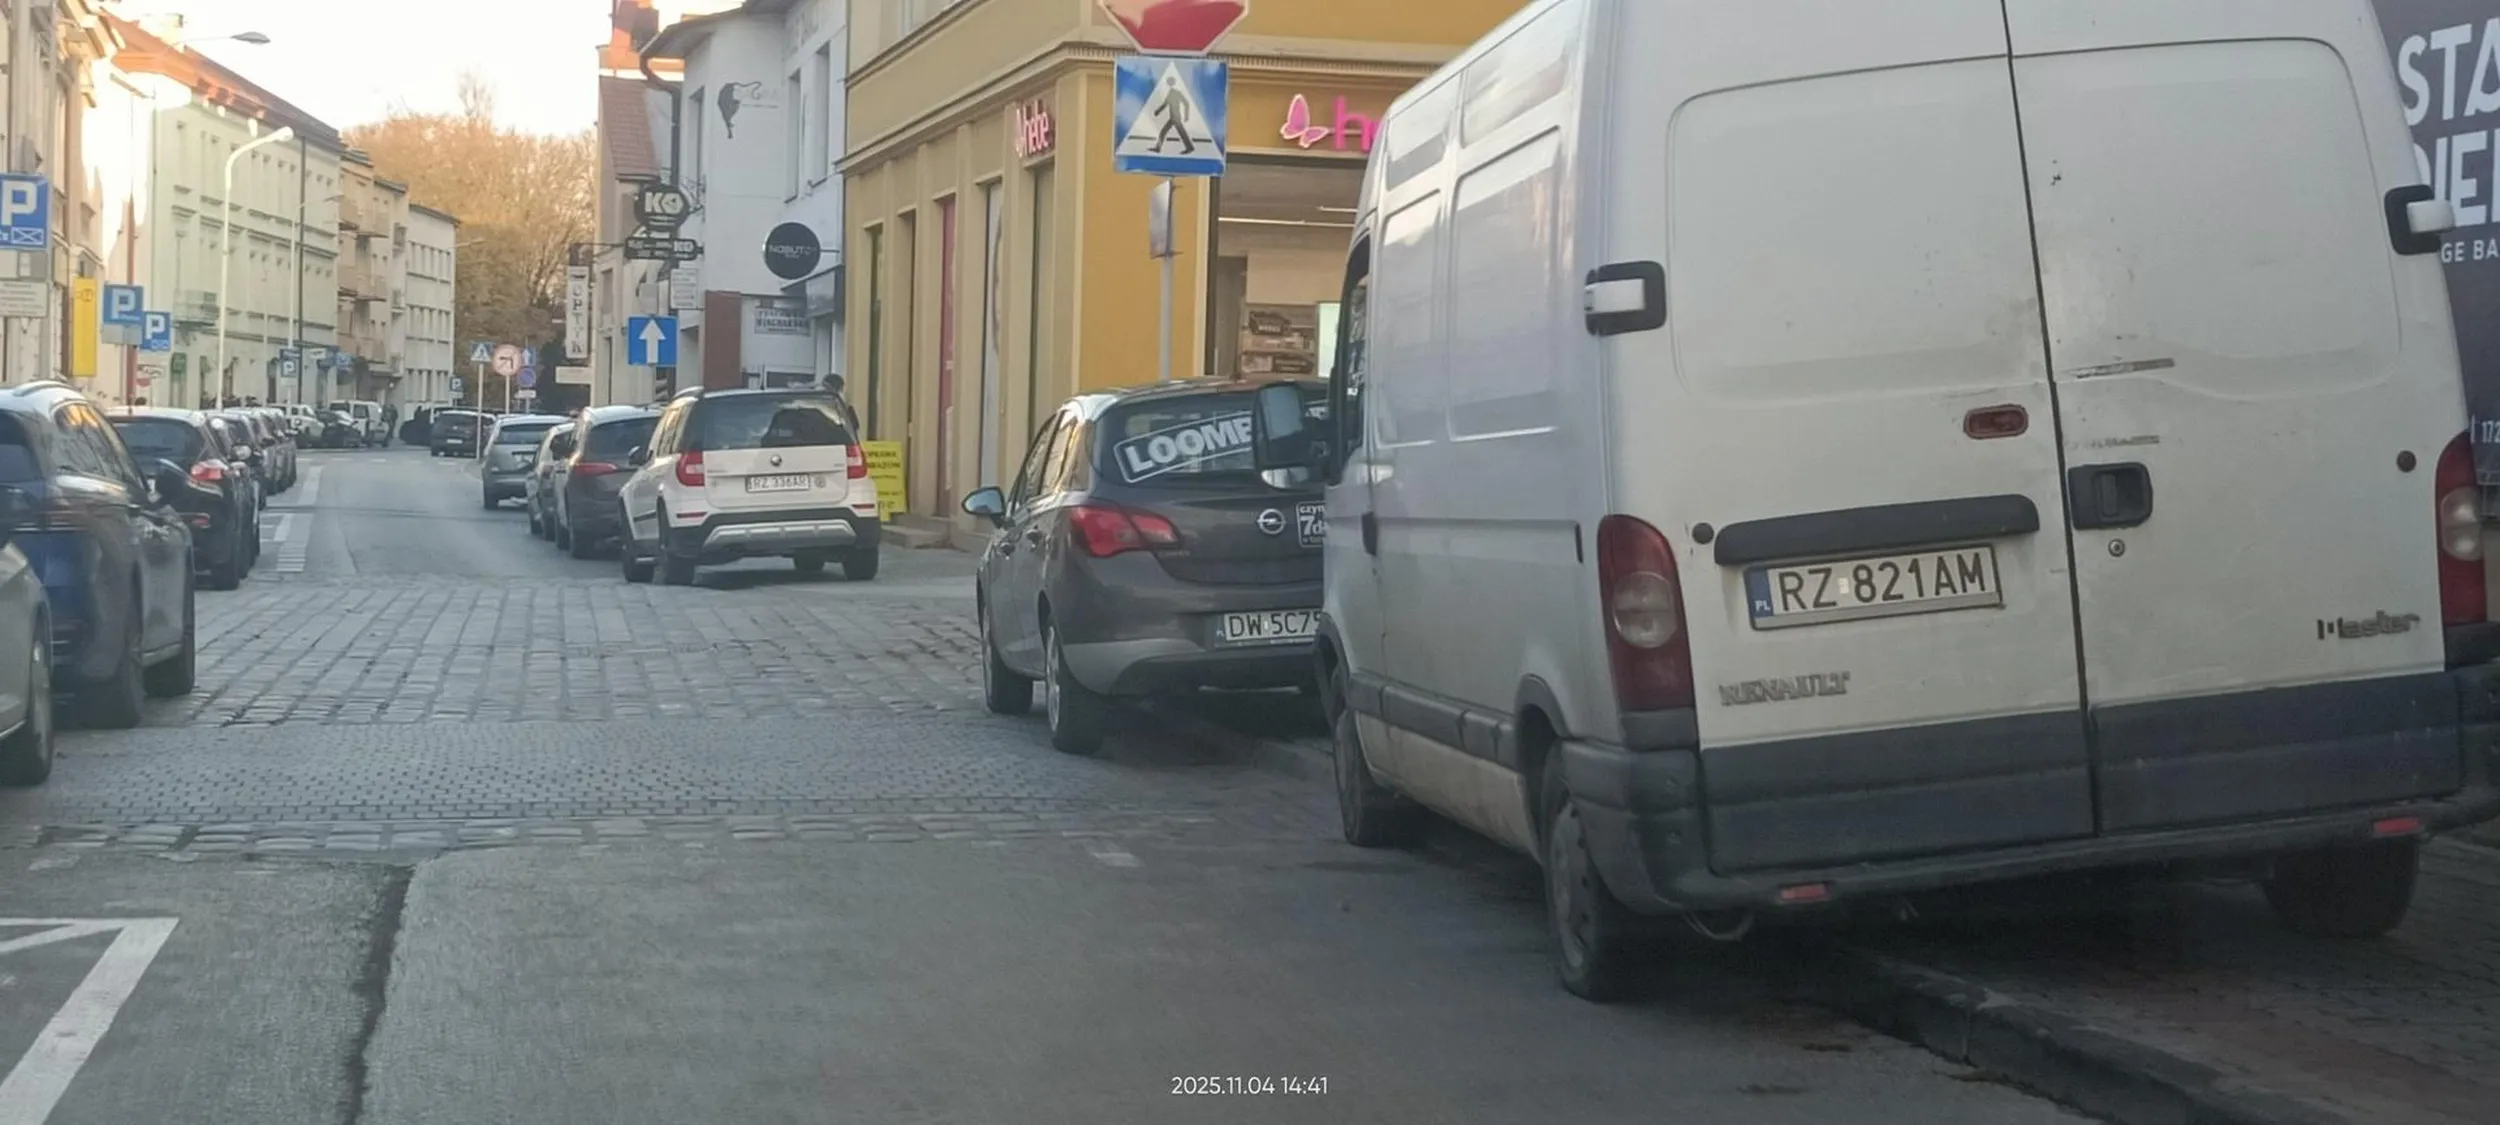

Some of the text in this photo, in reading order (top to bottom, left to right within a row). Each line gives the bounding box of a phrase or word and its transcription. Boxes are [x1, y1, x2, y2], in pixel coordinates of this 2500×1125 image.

[1023, 102, 1049, 157] hebe
[1335, 95, 1378, 152] h
[2, 180, 37, 225] P
[111, 288, 136, 320] P
[145, 314, 166, 340] P
[1778, 552, 1987, 611] RZ 821AM
[1755, 600, 1771, 611] PL
[1229, 615, 1263, 638] DW
[1719, 671, 1850, 706] RENAULT
